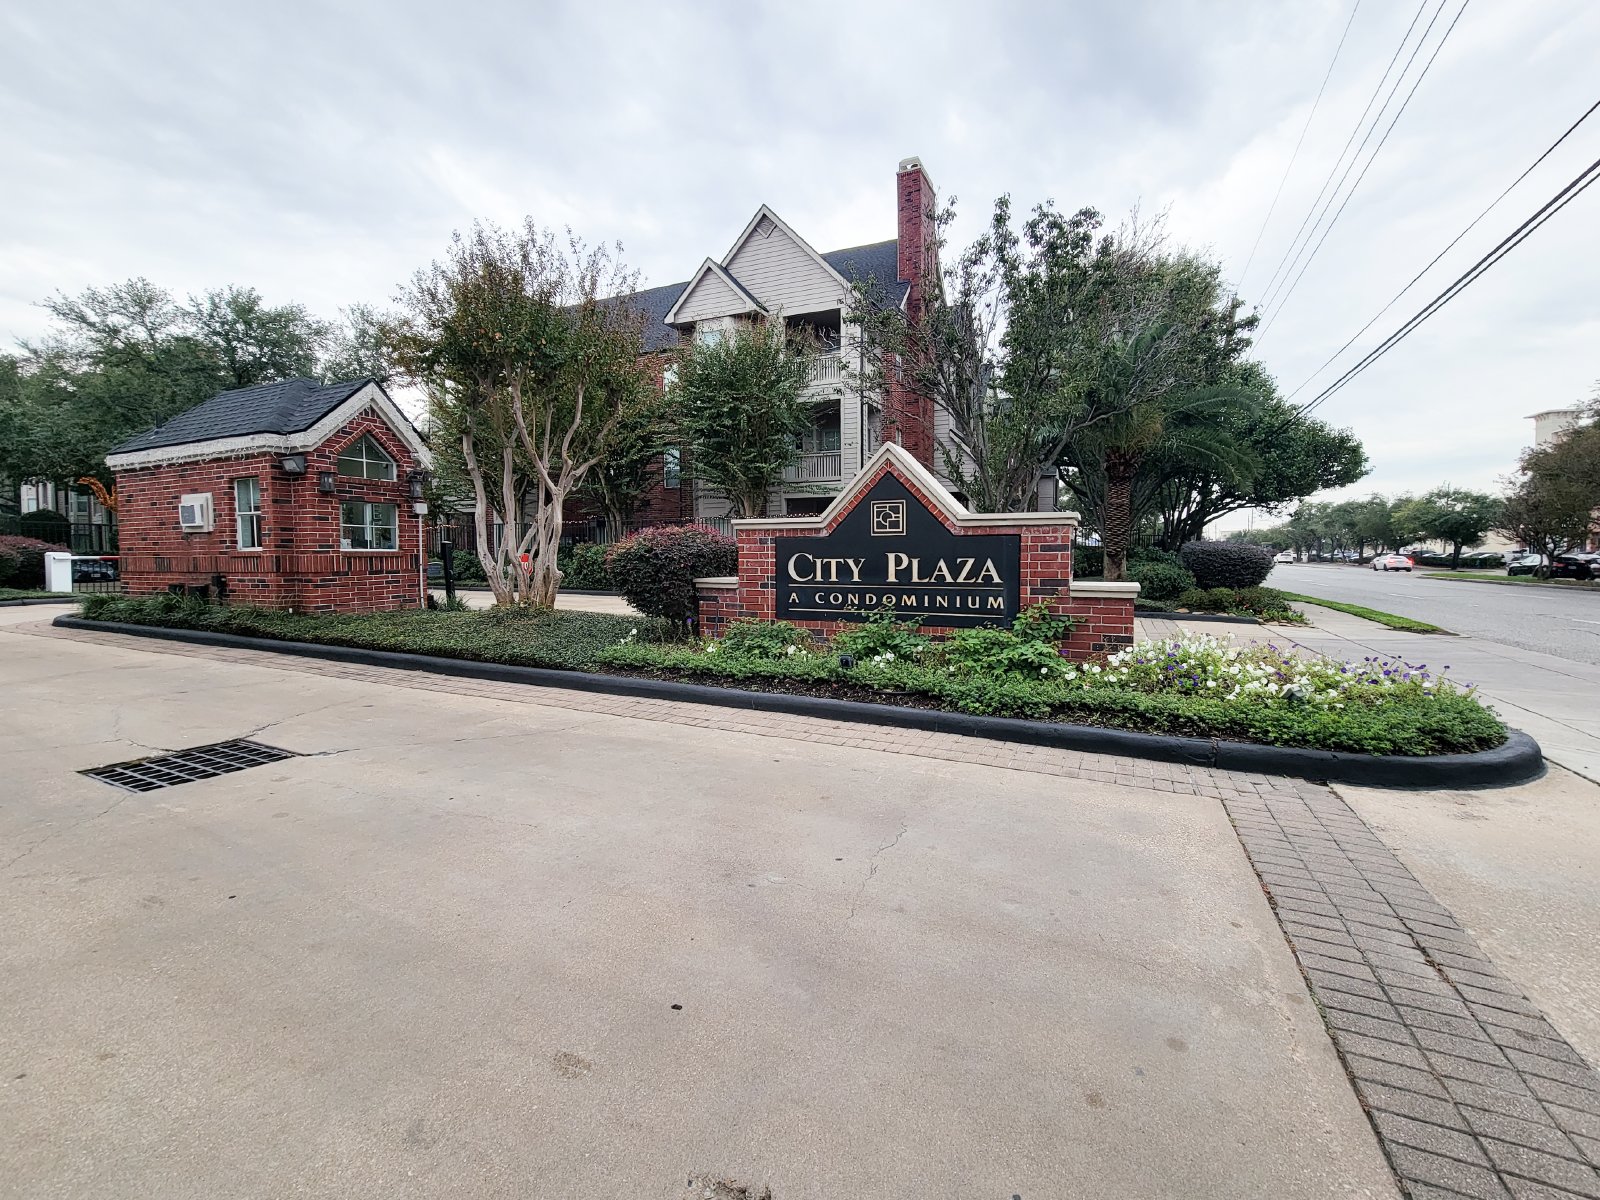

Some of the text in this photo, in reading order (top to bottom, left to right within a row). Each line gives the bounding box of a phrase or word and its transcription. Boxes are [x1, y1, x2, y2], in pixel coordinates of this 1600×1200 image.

[787, 552, 1004, 583] CITY PLAZA
[788, 592, 1005, 609] A CONDOMINIUM
